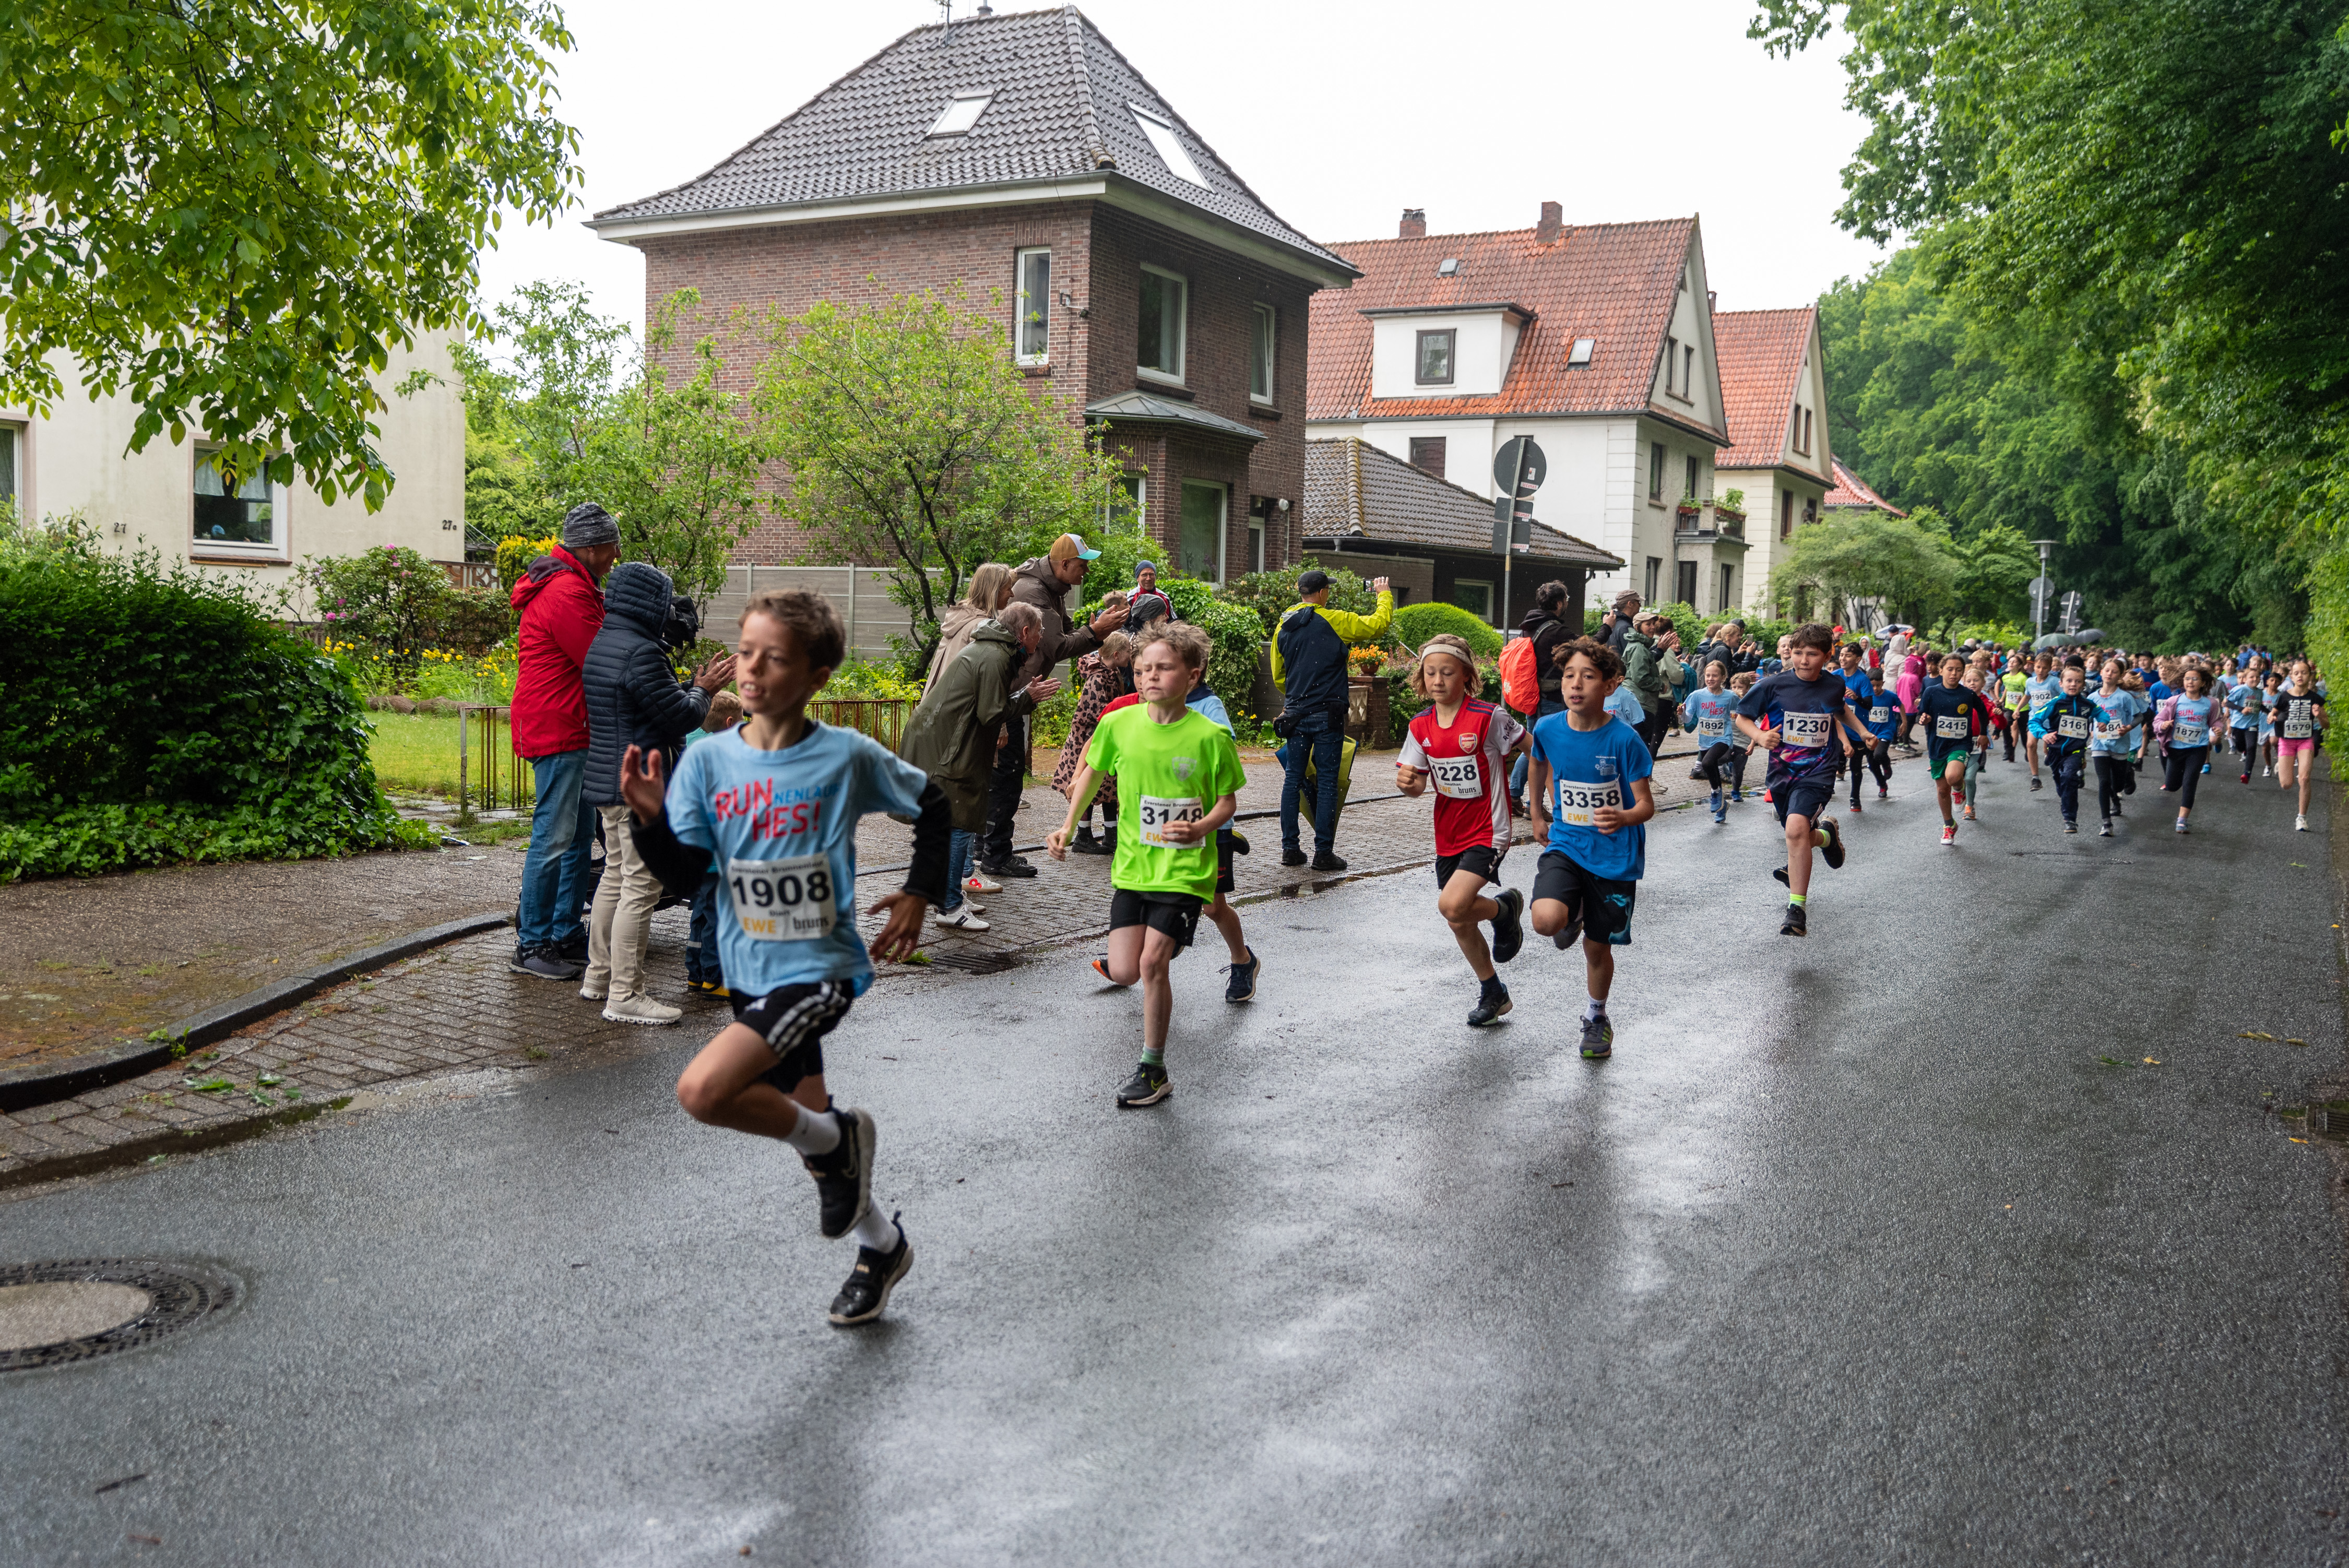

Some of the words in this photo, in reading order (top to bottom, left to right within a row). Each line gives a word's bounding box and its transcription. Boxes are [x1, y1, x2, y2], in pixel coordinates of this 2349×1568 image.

[114, 522, 126, 533] 27
[442, 519, 457, 530] 27a
[1701, 701, 1716, 710] RUN
[2288, 699, 2300, 721] RONG
[2300, 699, 2311, 720] MIND
[1700, 721, 1724, 730] 1892
[1786, 718, 1829, 733] 1230
[1938, 720, 1967, 730] 2415
[2060, 719, 2087, 730] 3161
[1787, 735, 1805, 743] EWE
[2176, 727, 2201, 738] 1877
[1432, 764, 1477, 781] 1228
[715, 777, 773, 822] RUN
[1562, 790, 1620, 809] 3358
[753, 801, 821, 841] HES!
[1142, 806, 1202, 825] 3148
[1568, 813, 1588, 822] EWE
[1146, 832, 1169, 844] EW
[732, 871, 831, 907] 1908
[743, 917, 777, 934] EWE
